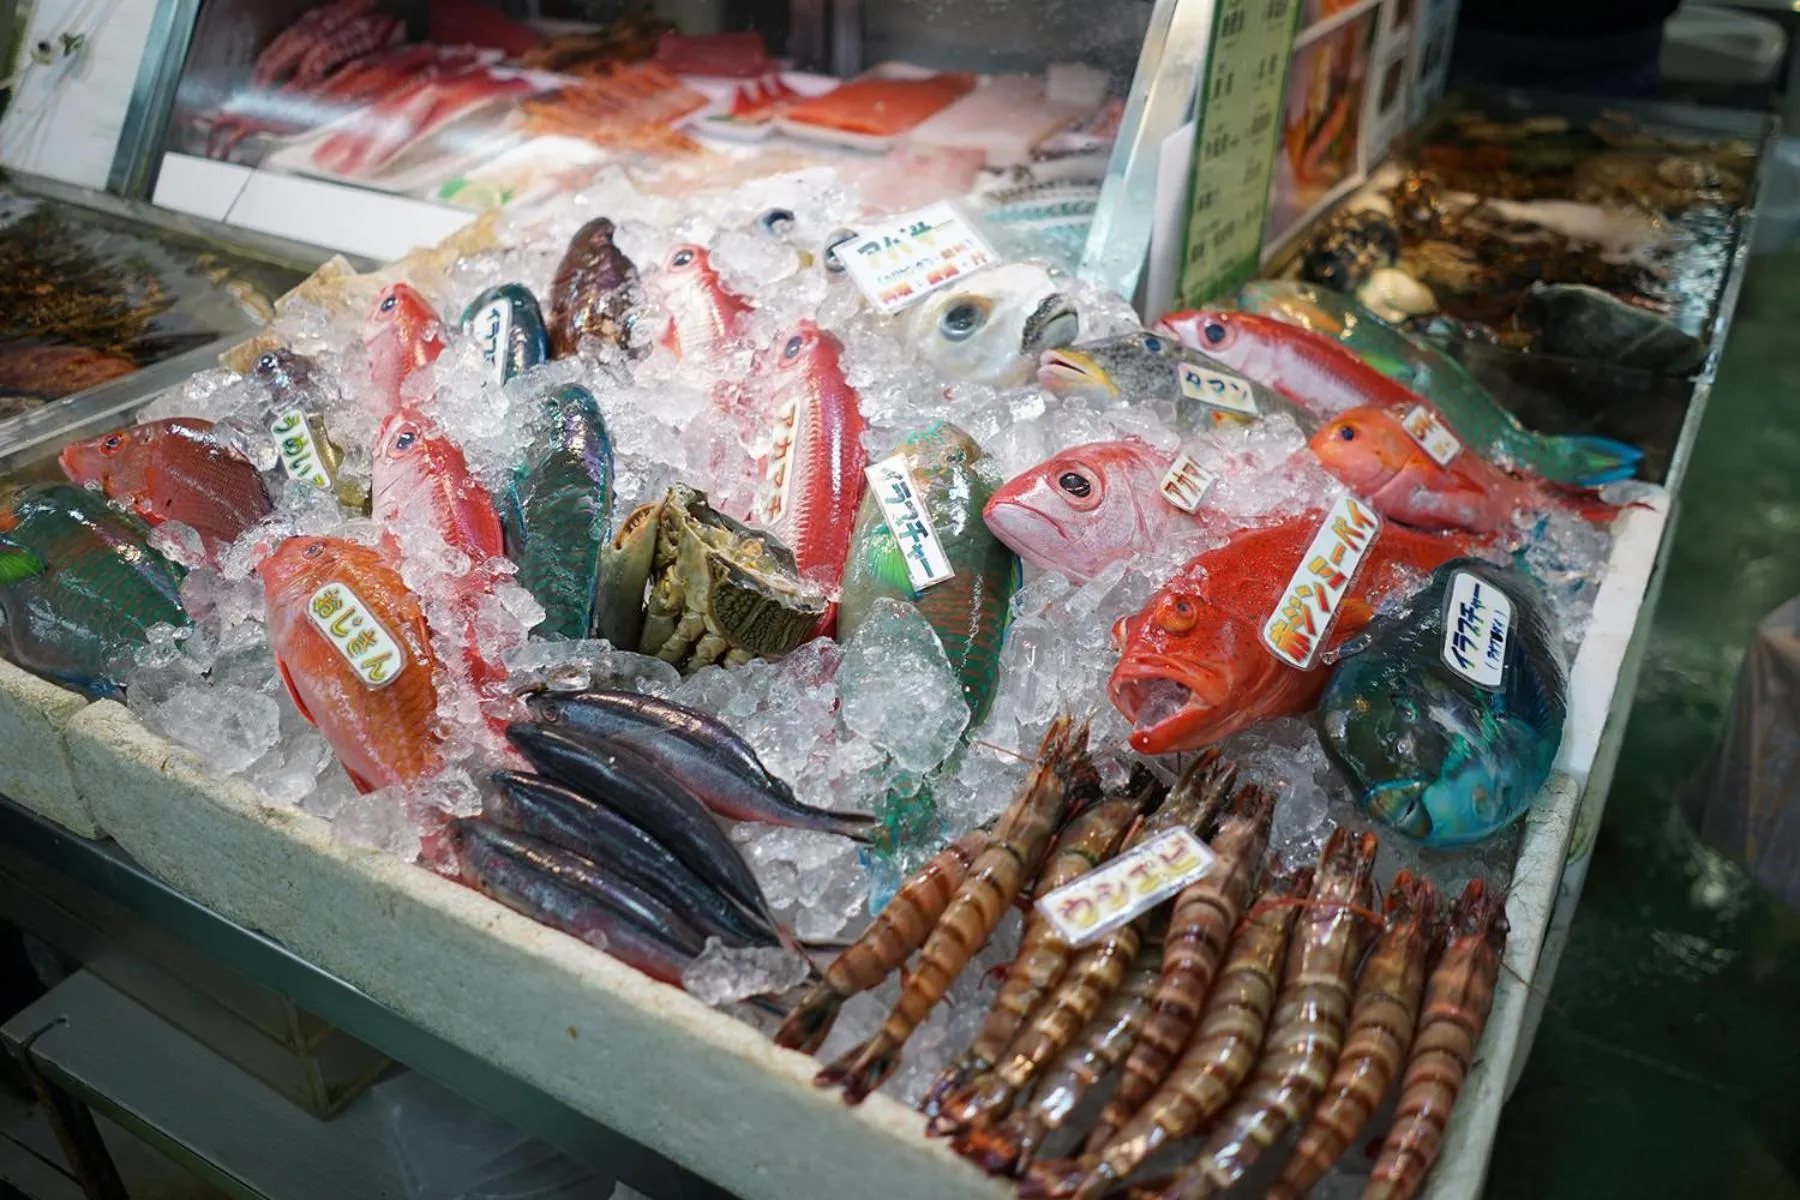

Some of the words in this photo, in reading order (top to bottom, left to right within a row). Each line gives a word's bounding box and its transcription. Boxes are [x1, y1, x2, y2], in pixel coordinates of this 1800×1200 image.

[1270, 498, 1375, 661] 赤ジンミーバイ
[1056, 837, 1201, 928] ウシエビ
